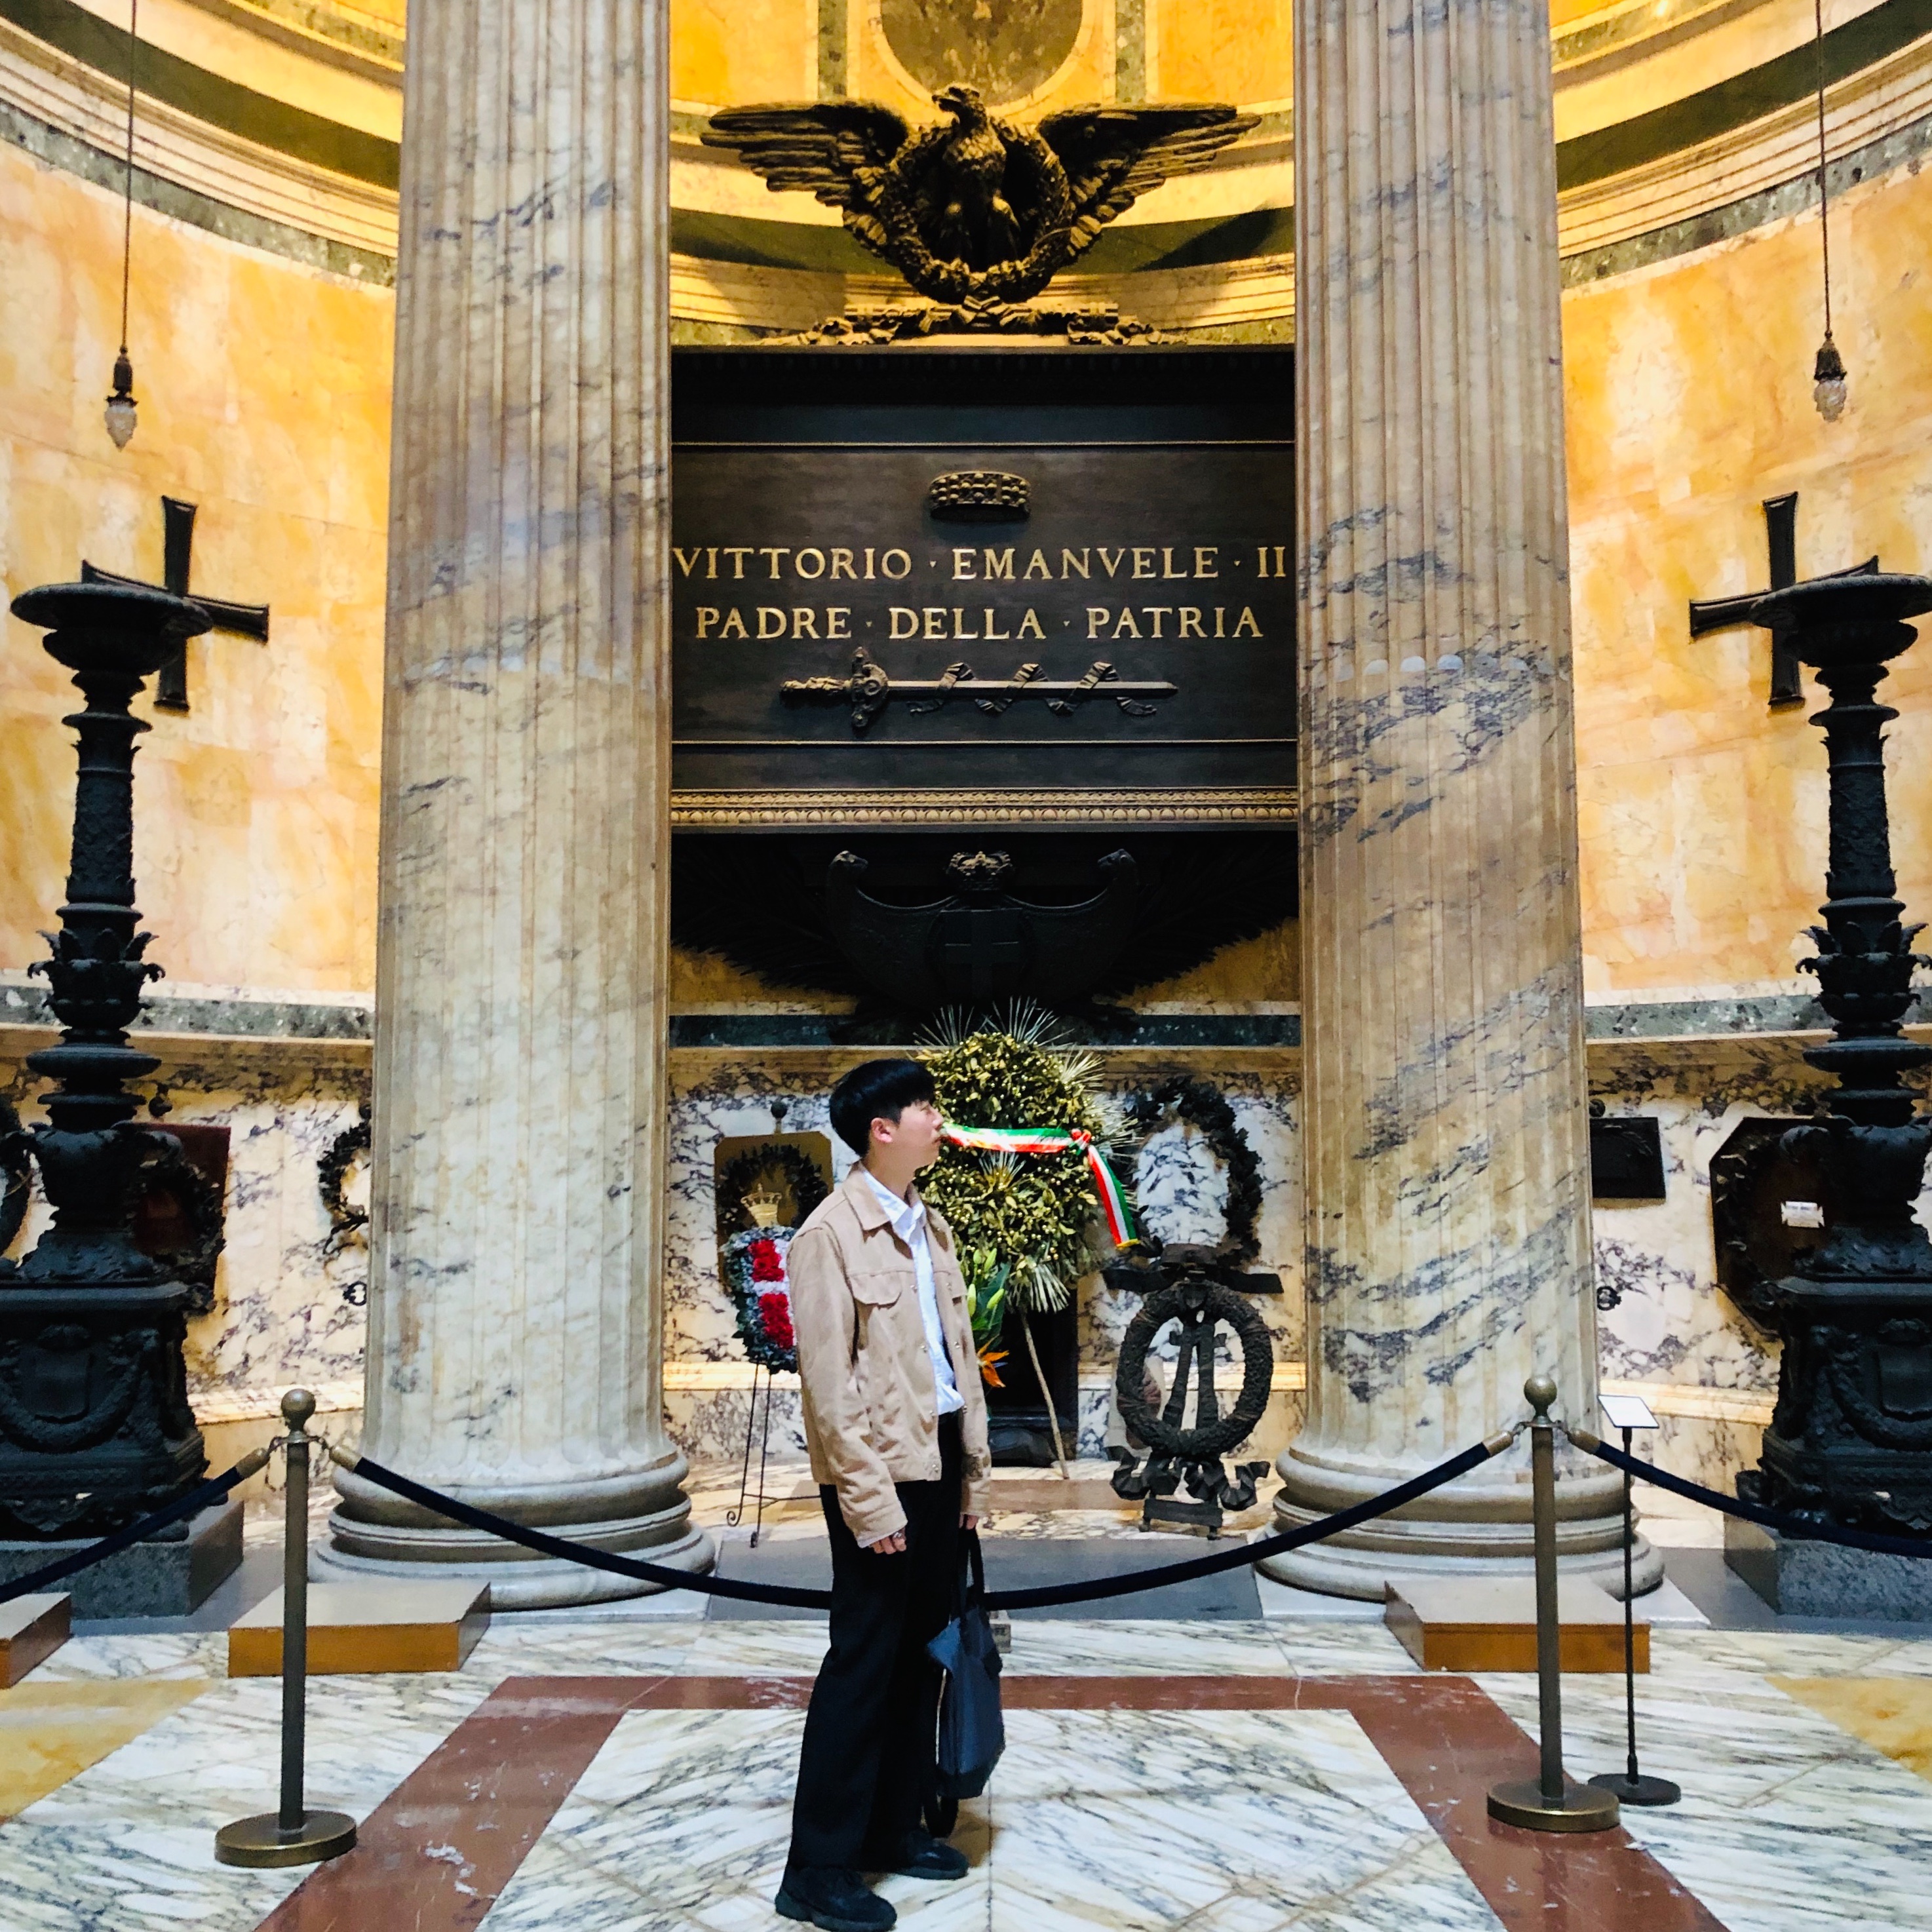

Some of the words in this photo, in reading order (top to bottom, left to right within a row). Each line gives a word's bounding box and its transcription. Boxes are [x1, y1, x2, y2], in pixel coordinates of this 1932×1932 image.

[672, 547, 912, 580] VITTORIO
[951, 547, 1218, 580] EMANVELE
[1257, 546, 1286, 578] II
[696, 607, 851, 640] PADRE
[888, 607, 1047, 640] DELLA
[1086, 606, 1264, 639] PATRIA
